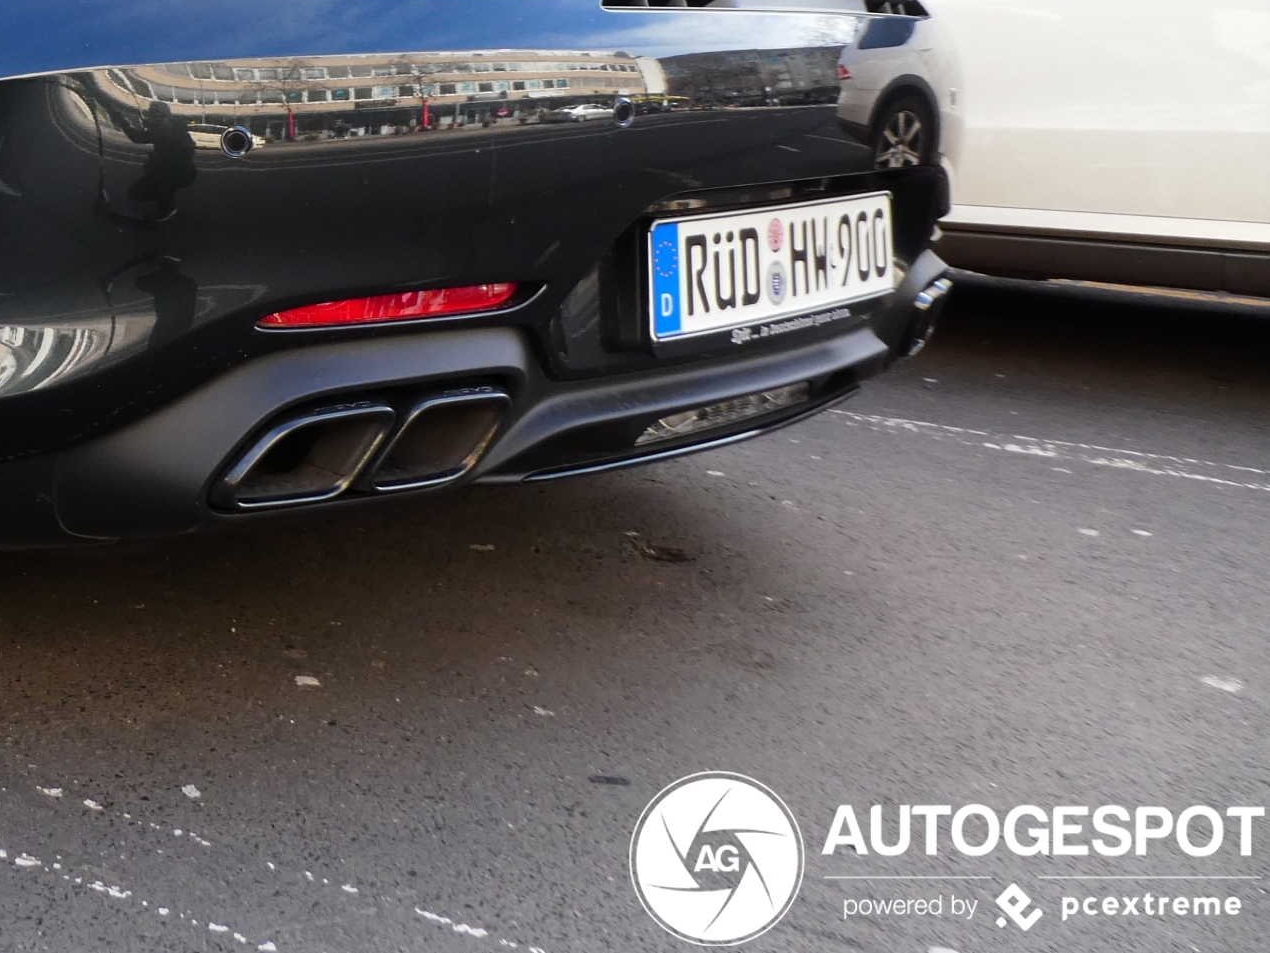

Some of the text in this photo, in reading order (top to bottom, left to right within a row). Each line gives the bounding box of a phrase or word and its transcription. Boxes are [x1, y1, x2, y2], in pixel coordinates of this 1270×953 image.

[790, 216, 828, 297] HW
[838, 208, 887, 287] 900
[661, 293, 673, 317] D
